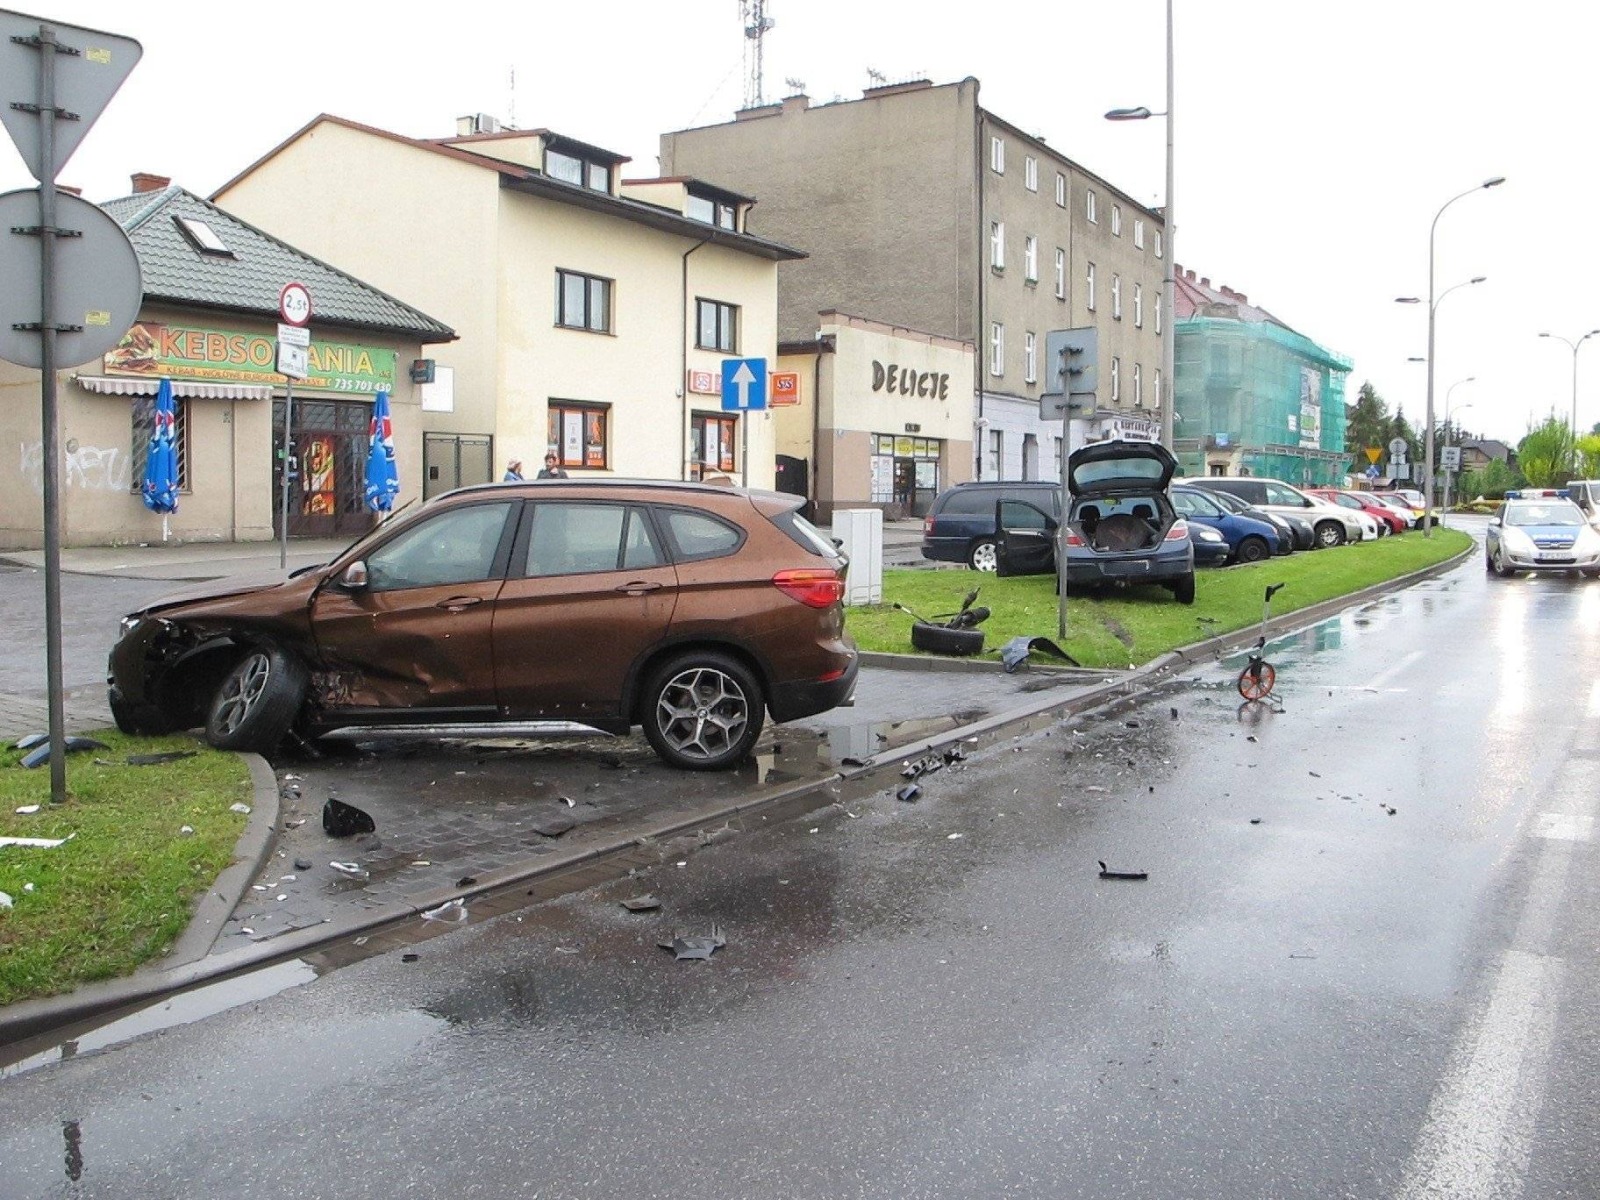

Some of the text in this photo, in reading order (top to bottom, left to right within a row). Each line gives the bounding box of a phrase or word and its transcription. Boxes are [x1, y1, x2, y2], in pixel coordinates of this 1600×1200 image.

[286, 294, 307, 311] 2,5t
[160, 328, 375, 376] KEBSOANIA
[871, 360, 950, 401] DELICJE
